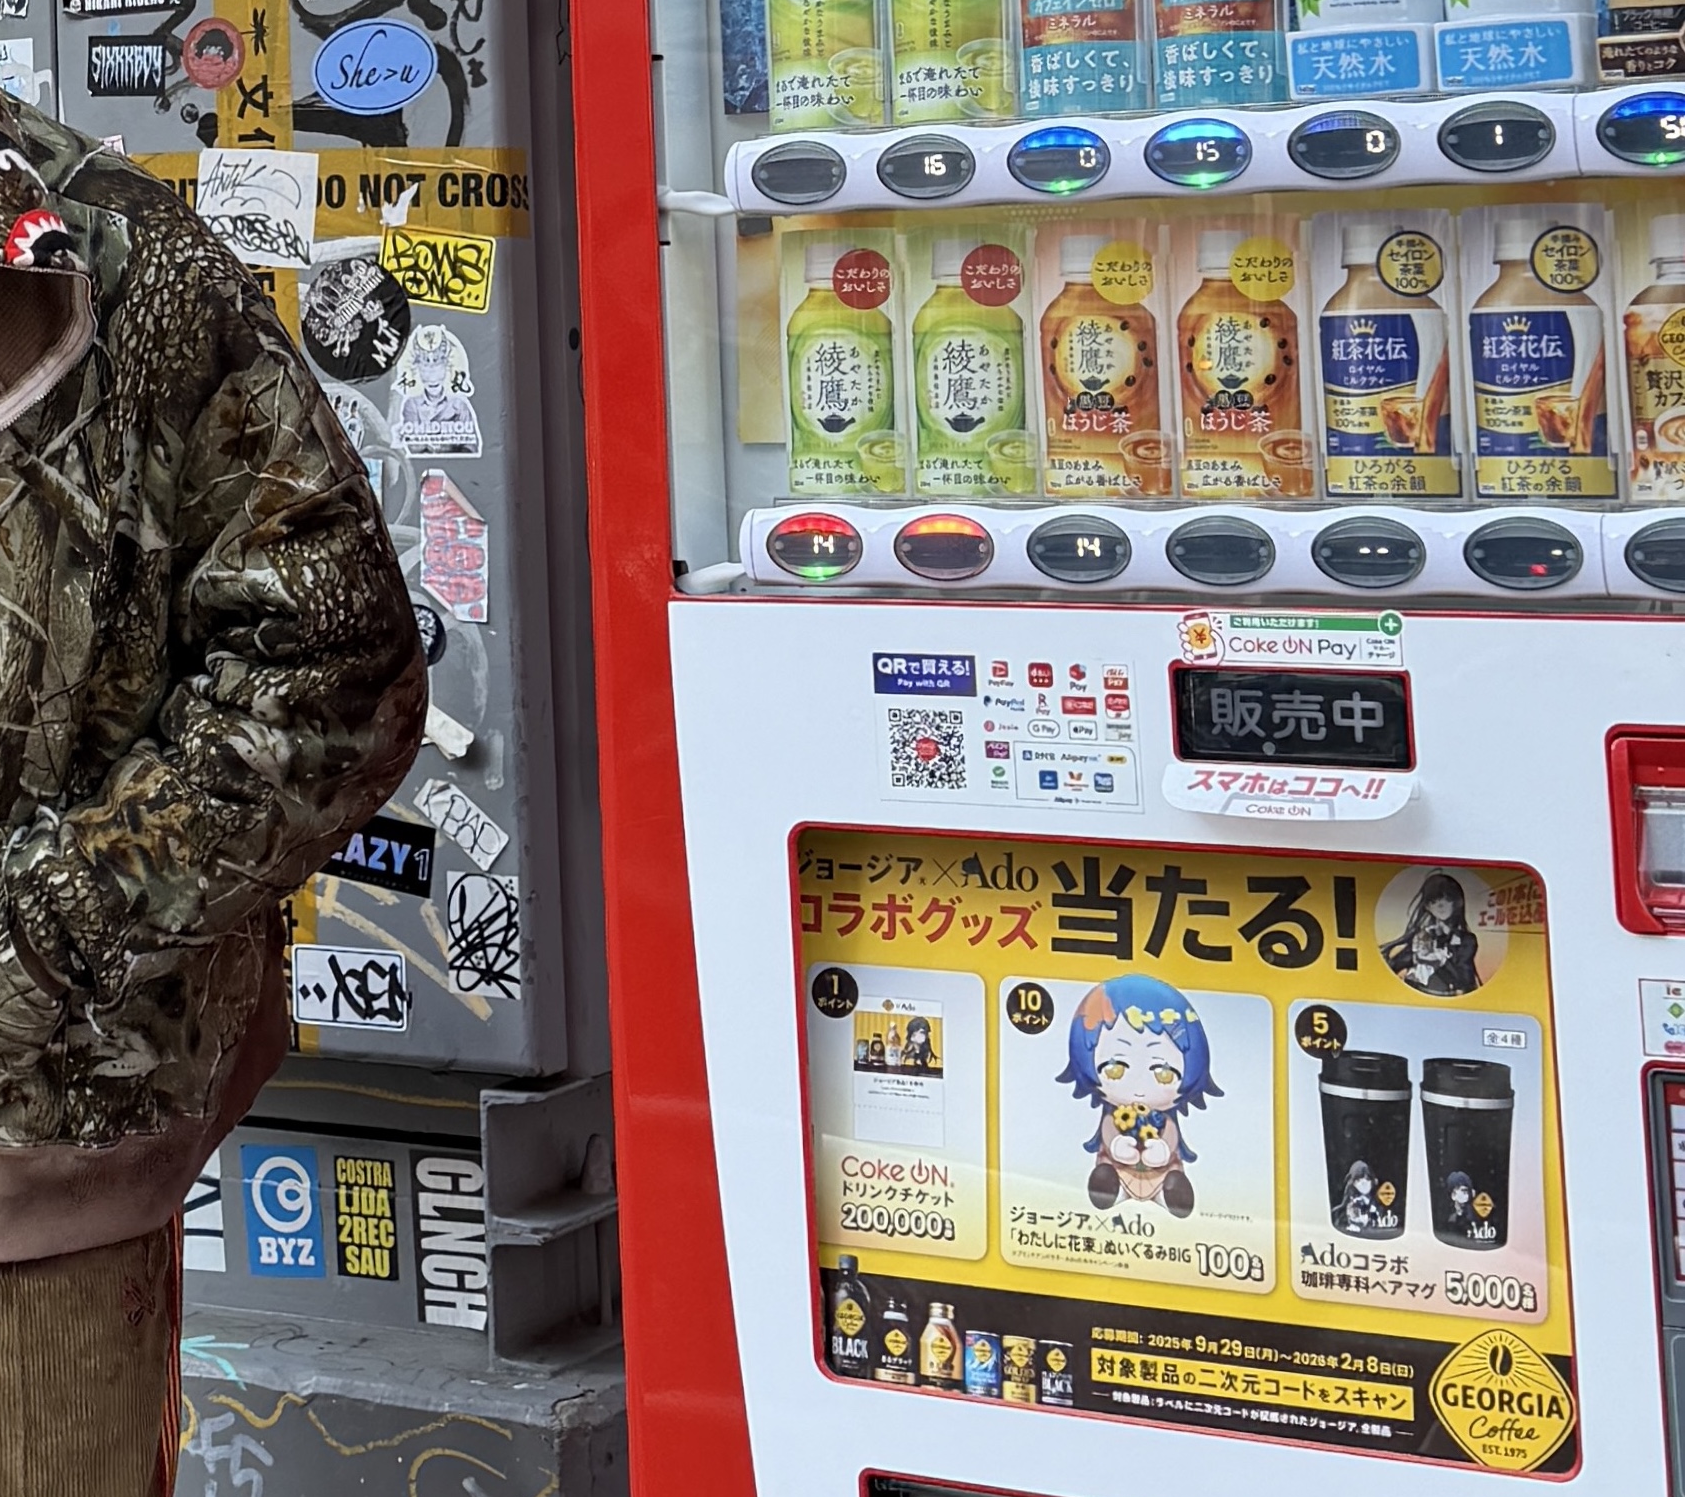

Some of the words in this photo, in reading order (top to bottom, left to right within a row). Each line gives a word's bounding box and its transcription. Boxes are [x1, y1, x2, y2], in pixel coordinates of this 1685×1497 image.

[1048, 17, 1096, 31] ミネラル
[1183, 5, 1234, 20] ミネラル
[1311, 51, 1397, 80] 天然水
[1459, 42, 1547, 70] 天然水
[1028, 74, 1134, 99] 後味すっきり
[1164, 65, 1273, 90] 後味すっきり
[358, 174, 425, 208] NOT
[1387, 247, 1435, 262] セイロン
[1542, 244, 1589, 259] セイロン
[1077, 320, 1105, 375] 綾鷹
[1215, 316, 1244, 371] 綾鷹
[1331, 337, 1410, 361] 紅茶花伝
[1482, 335, 1565, 360] 紅茶花伝
[815, 342, 850, 412] 綾鷹
[942, 339, 978, 411] 綾鷹
[1062, 412, 1133, 434] ほうじ茶
[1201, 411, 1272, 432] ほうじ茶
[1355, 460, 1416, 475] ひろがる
[1507, 459, 1571, 475] ひろがる
[1229, 637, 1279, 653] Coke
[1283, 636, 1312, 654] ON
[1318, 639, 1356, 659] Pay
[877, 658, 970, 676] QRで買える!
[1210, 688, 1384, 743] 販売中
[1187, 770, 1386, 800] スマホはココへ!!
[331, 833, 411, 875] AZY
[800, 892, 1042, 950] コラボグッズ
[1051, 856, 1359, 971] 当たる!
[818, 999, 853, 1010] ポイント
[1018, 990, 1041, 1011] 10
[1012, 1014, 1049, 1025] ポイント
[1314, 1013, 1329, 1034] 5
[1301, 1037, 1341, 1050] ポイント
[336, 1157, 393, 1187] COSTRA
[841, 1156, 904, 1182] Coke
[910, 1158, 949, 1186] ON
[842, 1180, 955, 1206] ドリンクチケット
[338, 1214, 395, 1248] 2REC
[258, 1237, 315, 1266] BYZ
[345, 1246, 390, 1278] SAU
[832, 1336, 868, 1359] BLACK
[1097, 1357, 1407, 1411] 対象製品の二次元コードをスキャン
[1442, 1382, 1565, 1420] GEORGIA
[1469, 1416, 1540, 1442] Coffee
